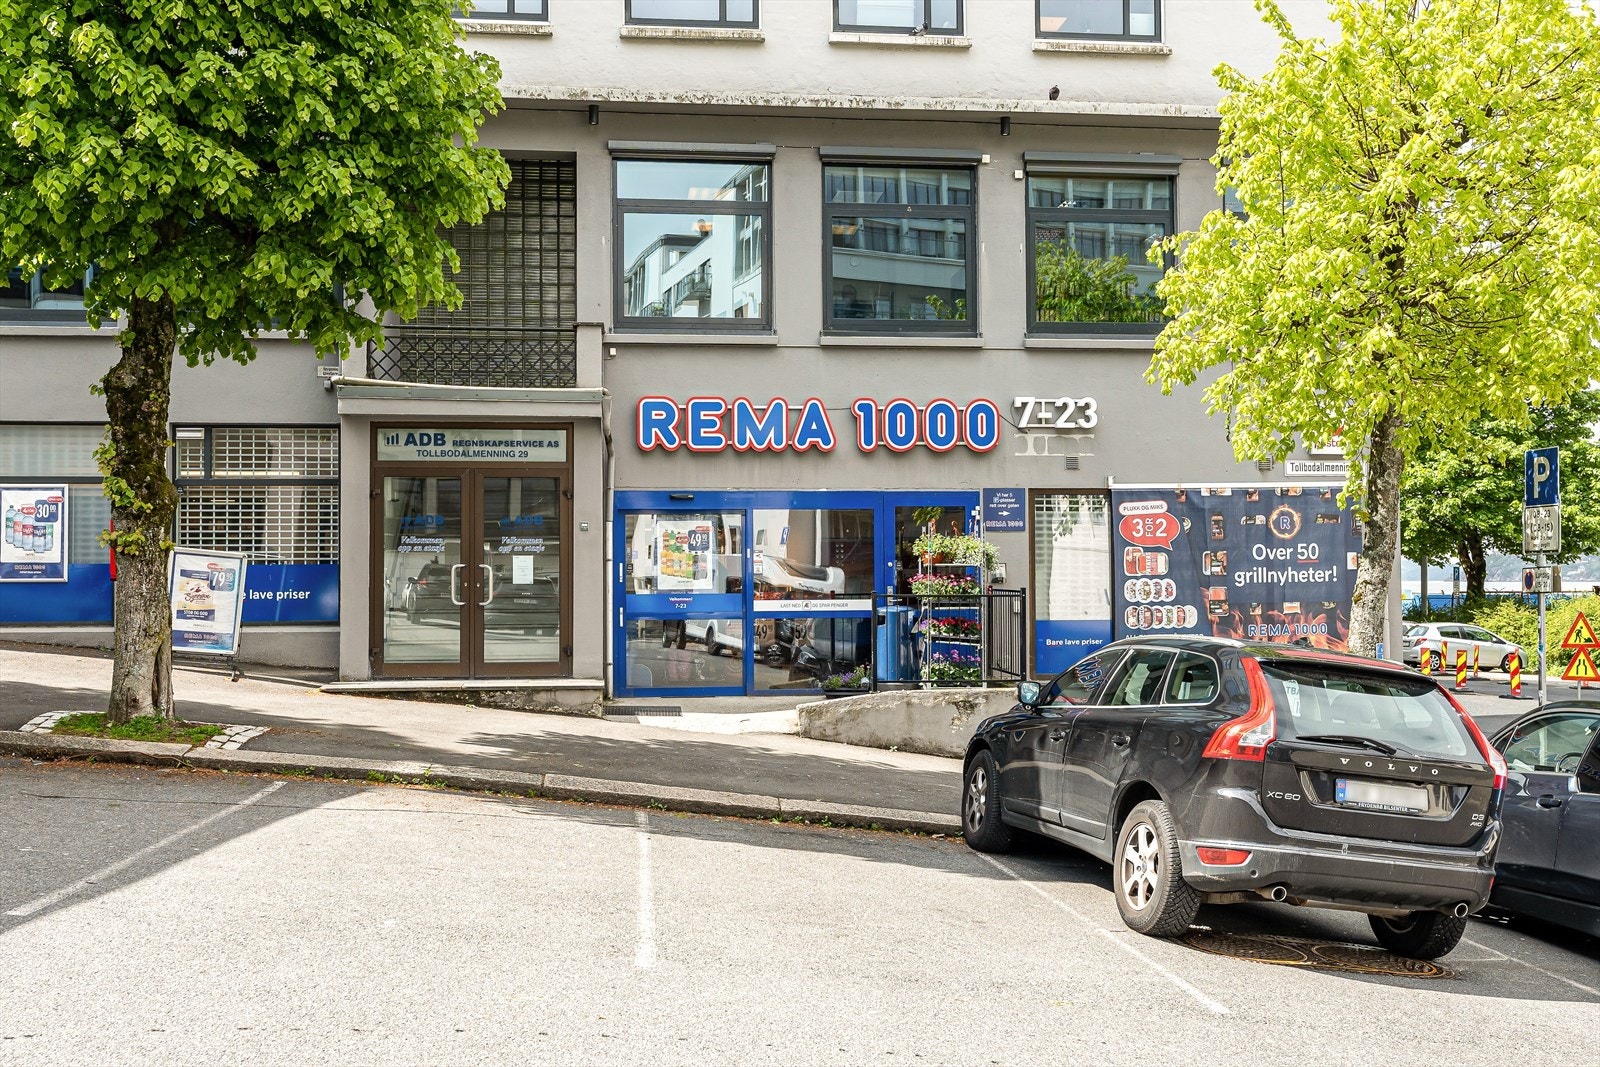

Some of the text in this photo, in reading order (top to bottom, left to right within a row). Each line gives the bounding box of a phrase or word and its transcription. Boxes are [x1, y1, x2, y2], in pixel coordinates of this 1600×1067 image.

[1014, 396, 1098, 428] 7-23
[636, 396, 1000, 453] REMA 1000
[404, 432, 446, 446] ADB
[416, 450, 516, 458] TOLLBODALMENNING
[1534, 456, 1550, 498] P
[36, 504, 49, 518] 30
[414, 514, 445, 525] ADB
[514, 515, 544, 525] ADB
[1280, 516, 1290, 529] R
[1132, 518, 1168, 538] 3 FOR 2
[690, 534, 701, 546] 49
[1252, 543, 1319, 560] Over 50
[212, 572, 225, 586] 79
[1234, 566, 1338, 586] grillnyheter!
[250, 589, 273, 599] lave
[277, 589, 310, 601] priser
[756, 625, 767, 639] 49
[1248, 623, 1328, 636] REMA 1000
[1286, 686, 1299, 695] TB
[1340, 758, 1438, 775] VOLVO
